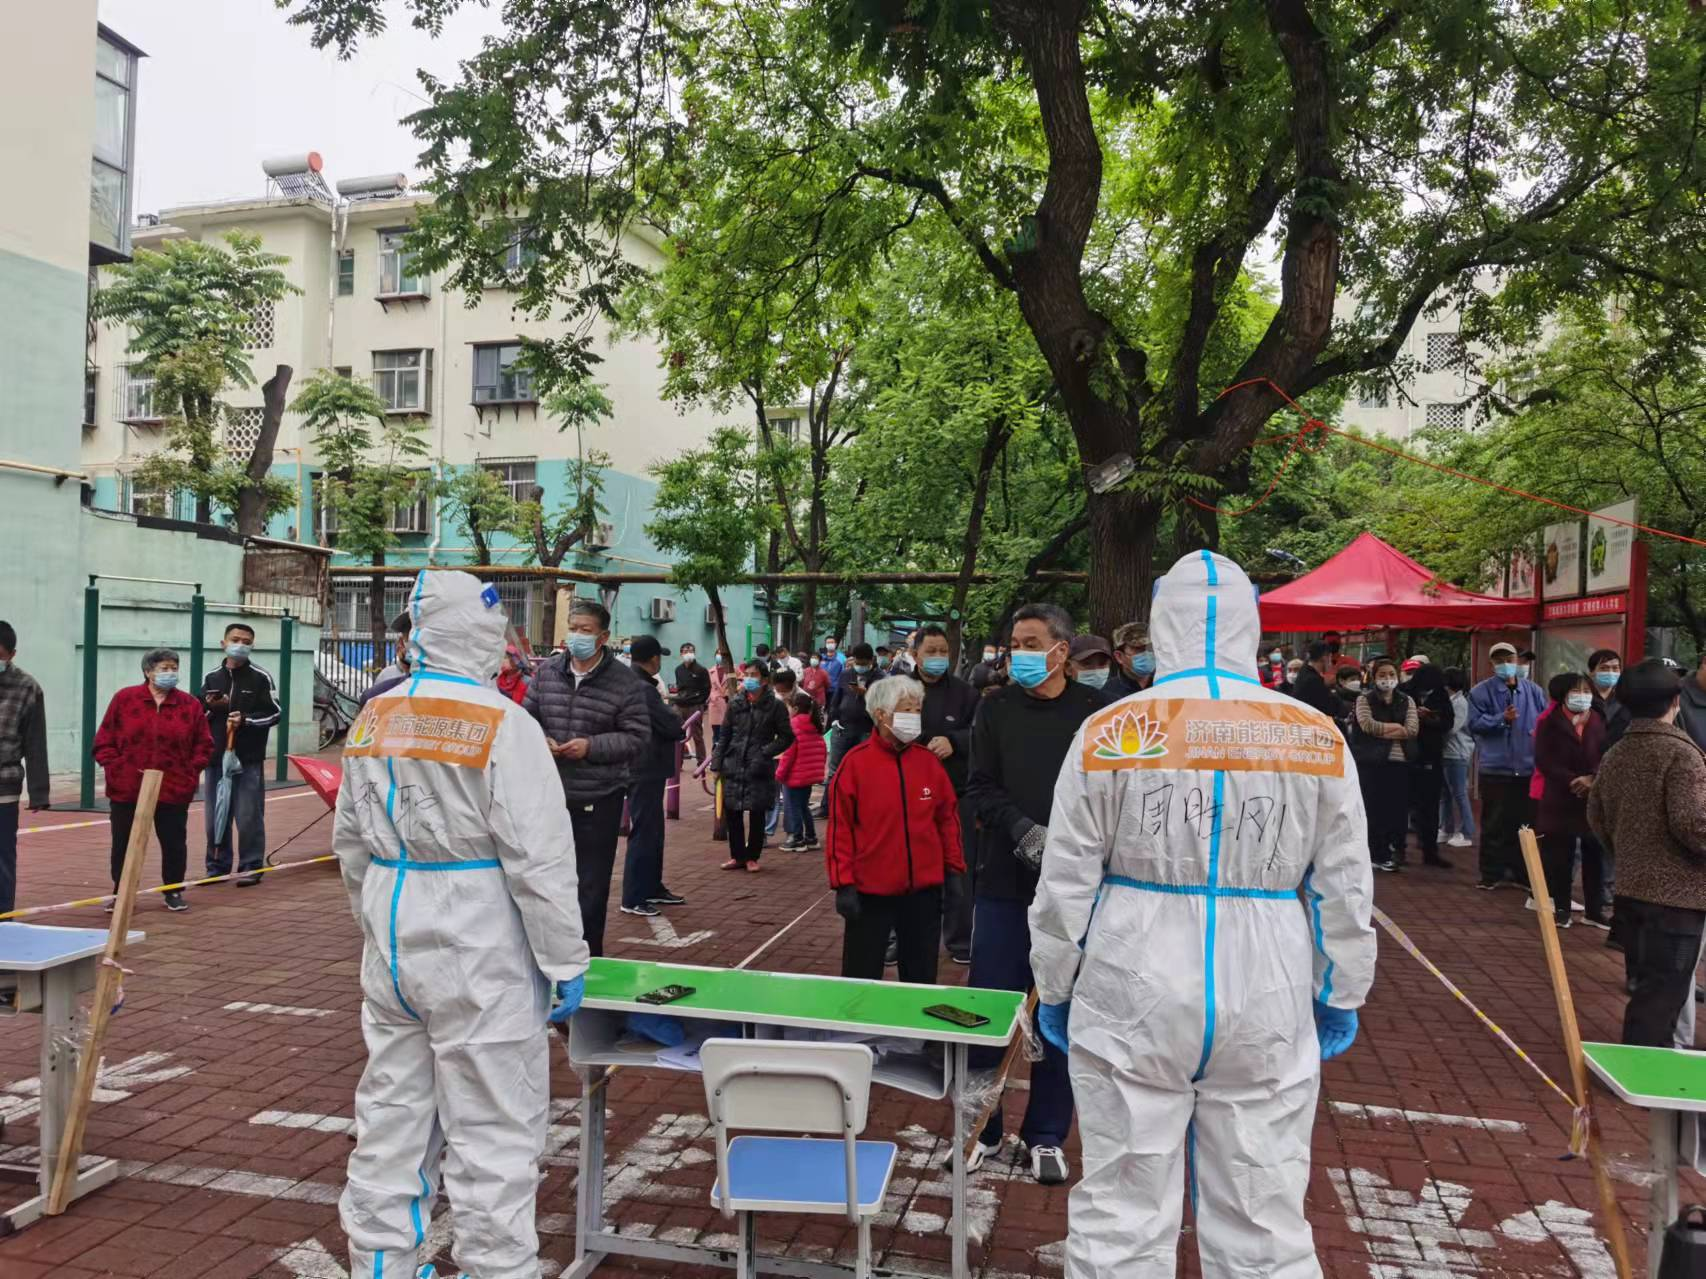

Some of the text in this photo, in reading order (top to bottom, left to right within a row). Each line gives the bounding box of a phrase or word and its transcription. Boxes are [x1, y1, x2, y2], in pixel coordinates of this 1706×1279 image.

[1186, 720, 1335, 749] 济南能源集团
